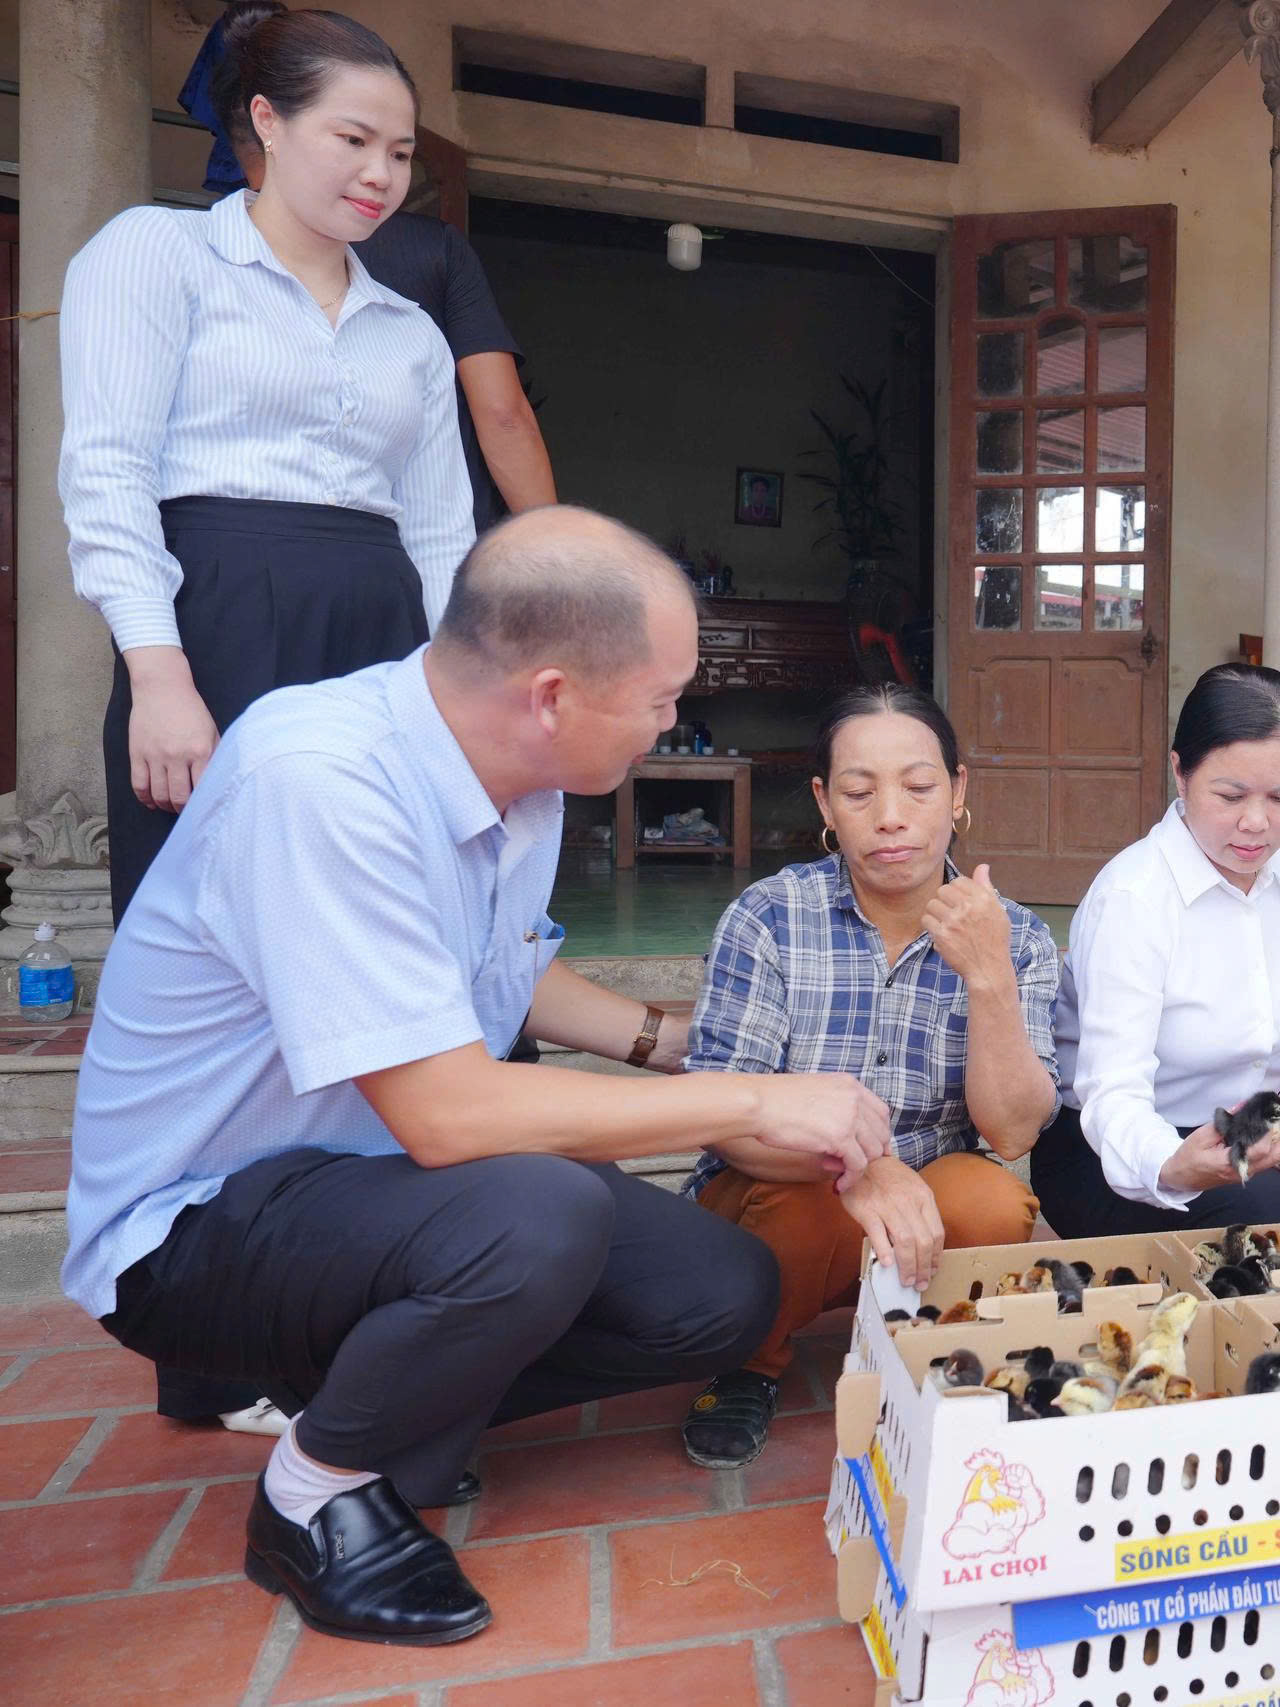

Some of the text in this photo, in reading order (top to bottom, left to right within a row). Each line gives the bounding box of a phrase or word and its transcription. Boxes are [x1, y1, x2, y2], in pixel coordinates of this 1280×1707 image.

[943, 1555, 1047, 1585] LAI CHỌI
[1120, 1544, 1190, 1574] SÔNG
[1200, 1531, 1248, 1561] CẦU
[1096, 1602, 1140, 1630] CÔNG
[1142, 1598, 1164, 1622] TY
[1166, 1585, 1186, 1619] CỔ
[1189, 1581, 1230, 1615] PHẦN
[1232, 1576, 1262, 1609] ĐẦU
